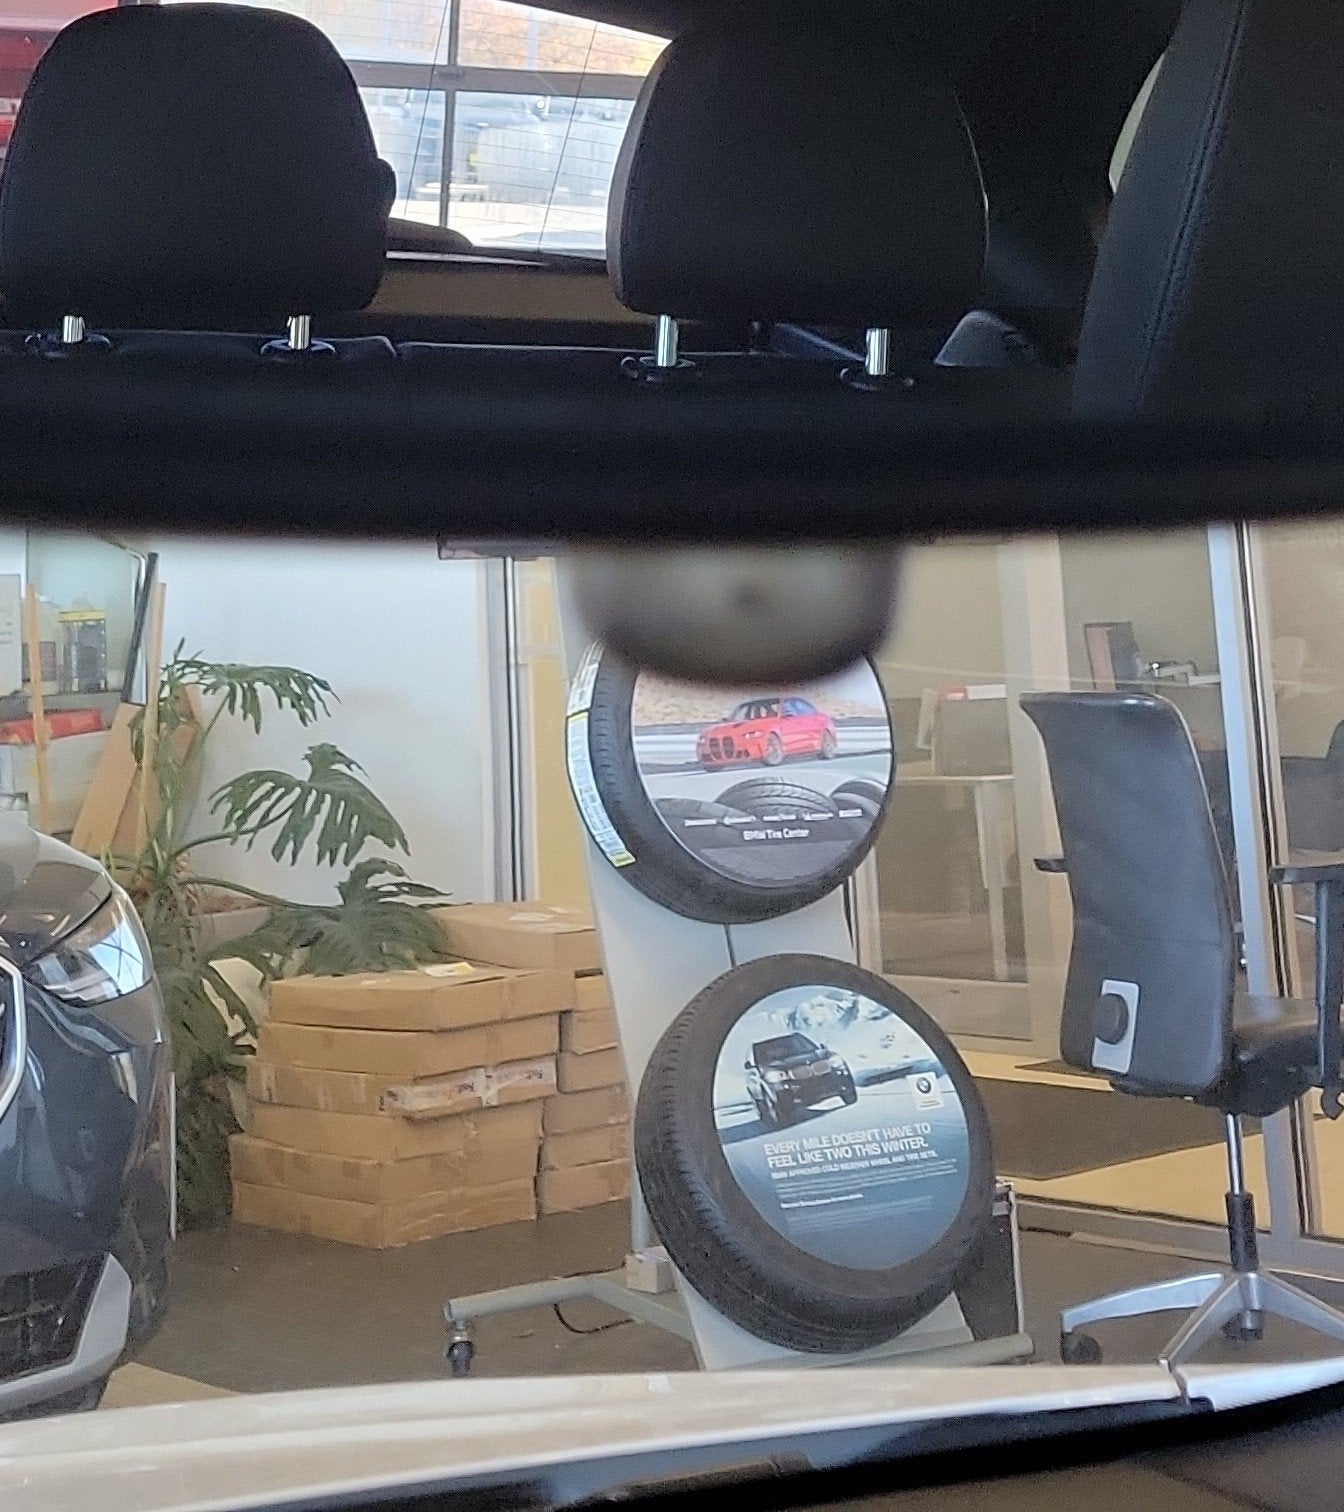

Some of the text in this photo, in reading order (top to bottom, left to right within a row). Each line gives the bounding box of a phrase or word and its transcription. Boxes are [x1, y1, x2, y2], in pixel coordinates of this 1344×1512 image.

[764, 1140, 800, 1155] EVERY
[803, 1135, 831, 1150] MILE
[882, 1125, 914, 1140] HAVE
[914, 1122, 931, 1135] TO
[767, 1155, 797, 1168] FEEL
[797, 1150, 824, 1164] LIKE
[823, 1146, 853, 1160] TWO
[852, 1142, 881, 1157] THIS
